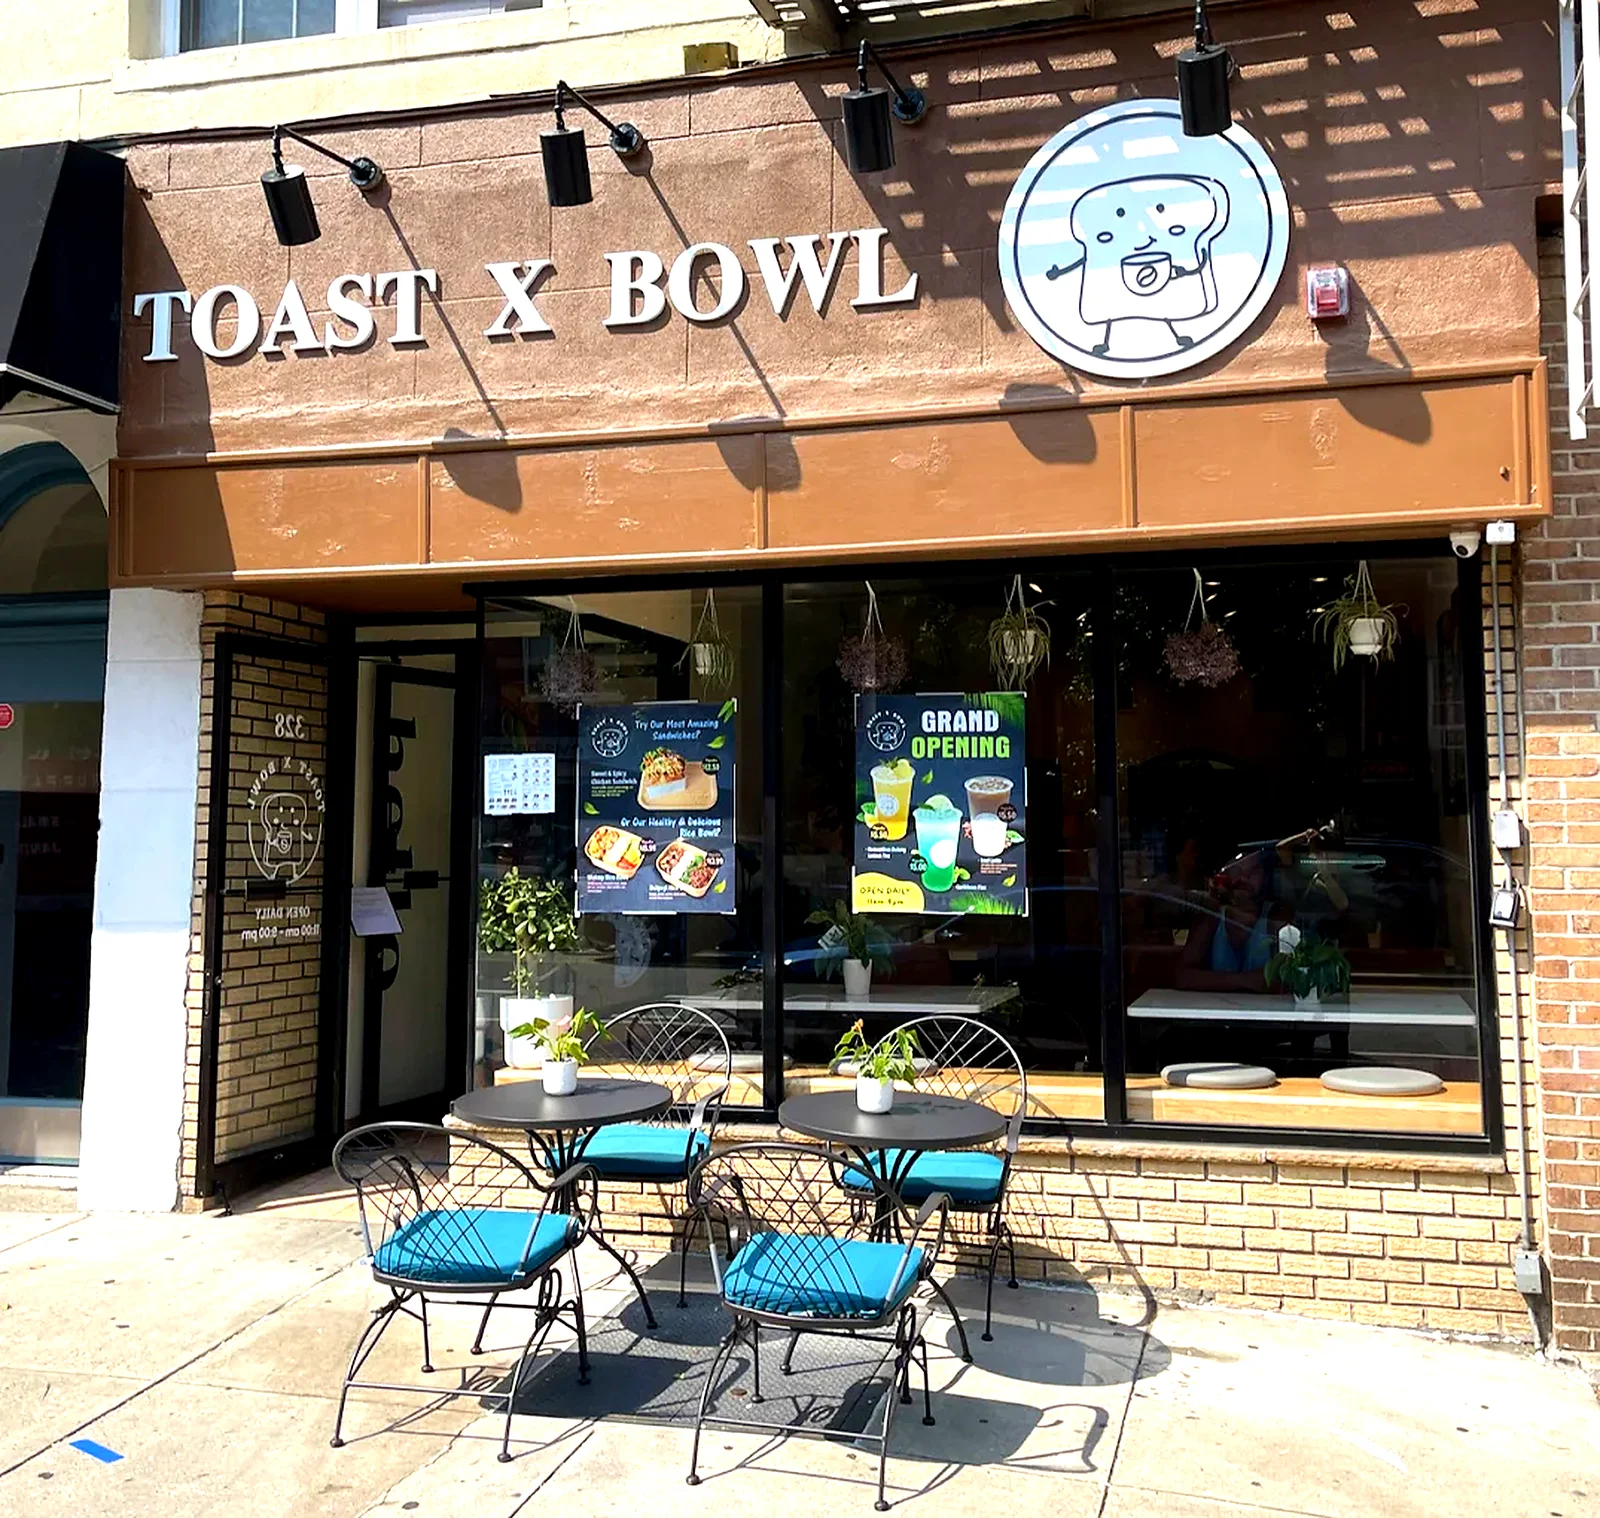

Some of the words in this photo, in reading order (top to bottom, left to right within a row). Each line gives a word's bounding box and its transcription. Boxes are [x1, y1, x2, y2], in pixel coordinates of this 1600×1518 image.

[134, 268, 438, 363] TOAST
[484, 259, 555, 337] X
[603, 227, 920, 328] BOWL
[635, 719, 648, 731] Try
[650, 720, 664, 729] Our
[666, 719, 686, 729] Most
[687, 719, 720, 731] Amazing
[921, 710, 999, 732] GRAND
[652, 730, 701, 741] Sandwiches?
[911, 736, 1010, 758] OPENING
[621, 818, 630, 827] Or
[632, 817, 646, 827] Our
[649, 817, 677, 829] Healthy
[688, 817, 722, 827] Delicious
[680, 828, 696, 838] Rice
[859, 886, 884, 895] OPEN
[886, 886, 911, 895] DAILY
